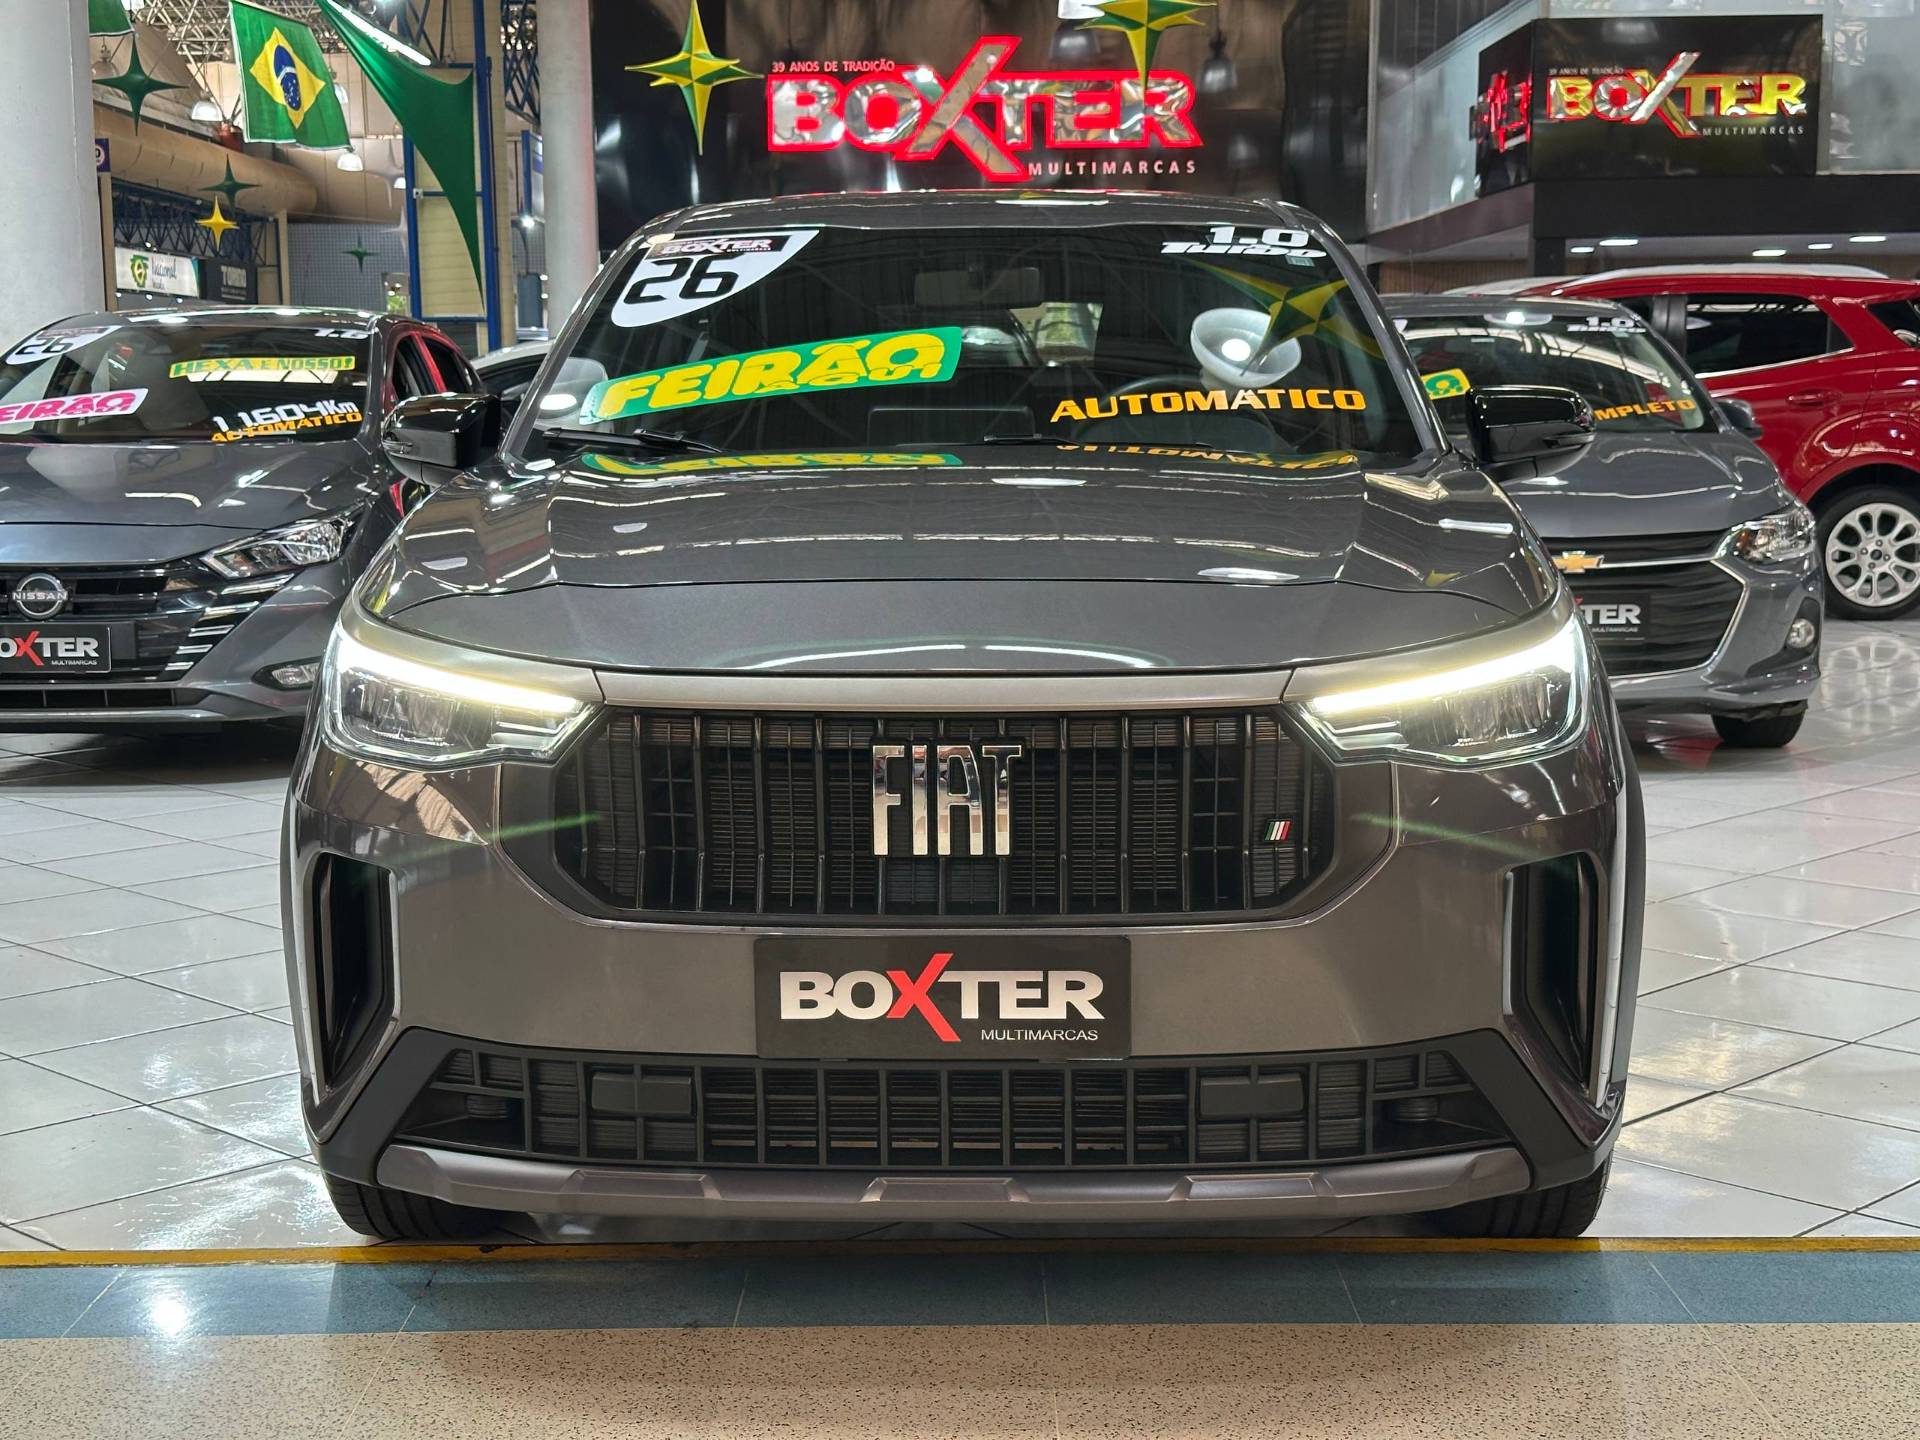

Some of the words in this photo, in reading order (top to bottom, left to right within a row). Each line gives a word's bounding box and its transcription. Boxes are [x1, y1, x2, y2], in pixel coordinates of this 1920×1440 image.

[772, 61, 786, 73] 39
[789, 61, 820, 73] ANOS
[824, 61, 839, 73] DE
[842, 58, 896, 72] TRADIÇÃO
[1547, 51, 1807, 138] BOXTER
[767, 35, 1204, 182] BOXTER
[1702, 125, 1804, 136] MULTIMARCAS
[1028, 160, 1196, 176] MULTIMARCAS
[661, 238, 773, 254] BOXTER
[1210, 226, 1309, 247] 1.0
[623, 252, 744, 304] 26
[15, 336, 74, 355] 26
[174, 358, 255, 376] HEXA
[596, 333, 945, 418] FEIRÃO
[12, 591, 68, 600] NISSAN
[873, 745, 1022, 856] FIAT
[780, 953, 1105, 1042] BOXTER
[981, 1029, 1099, 1041] MULTIMARCAS
